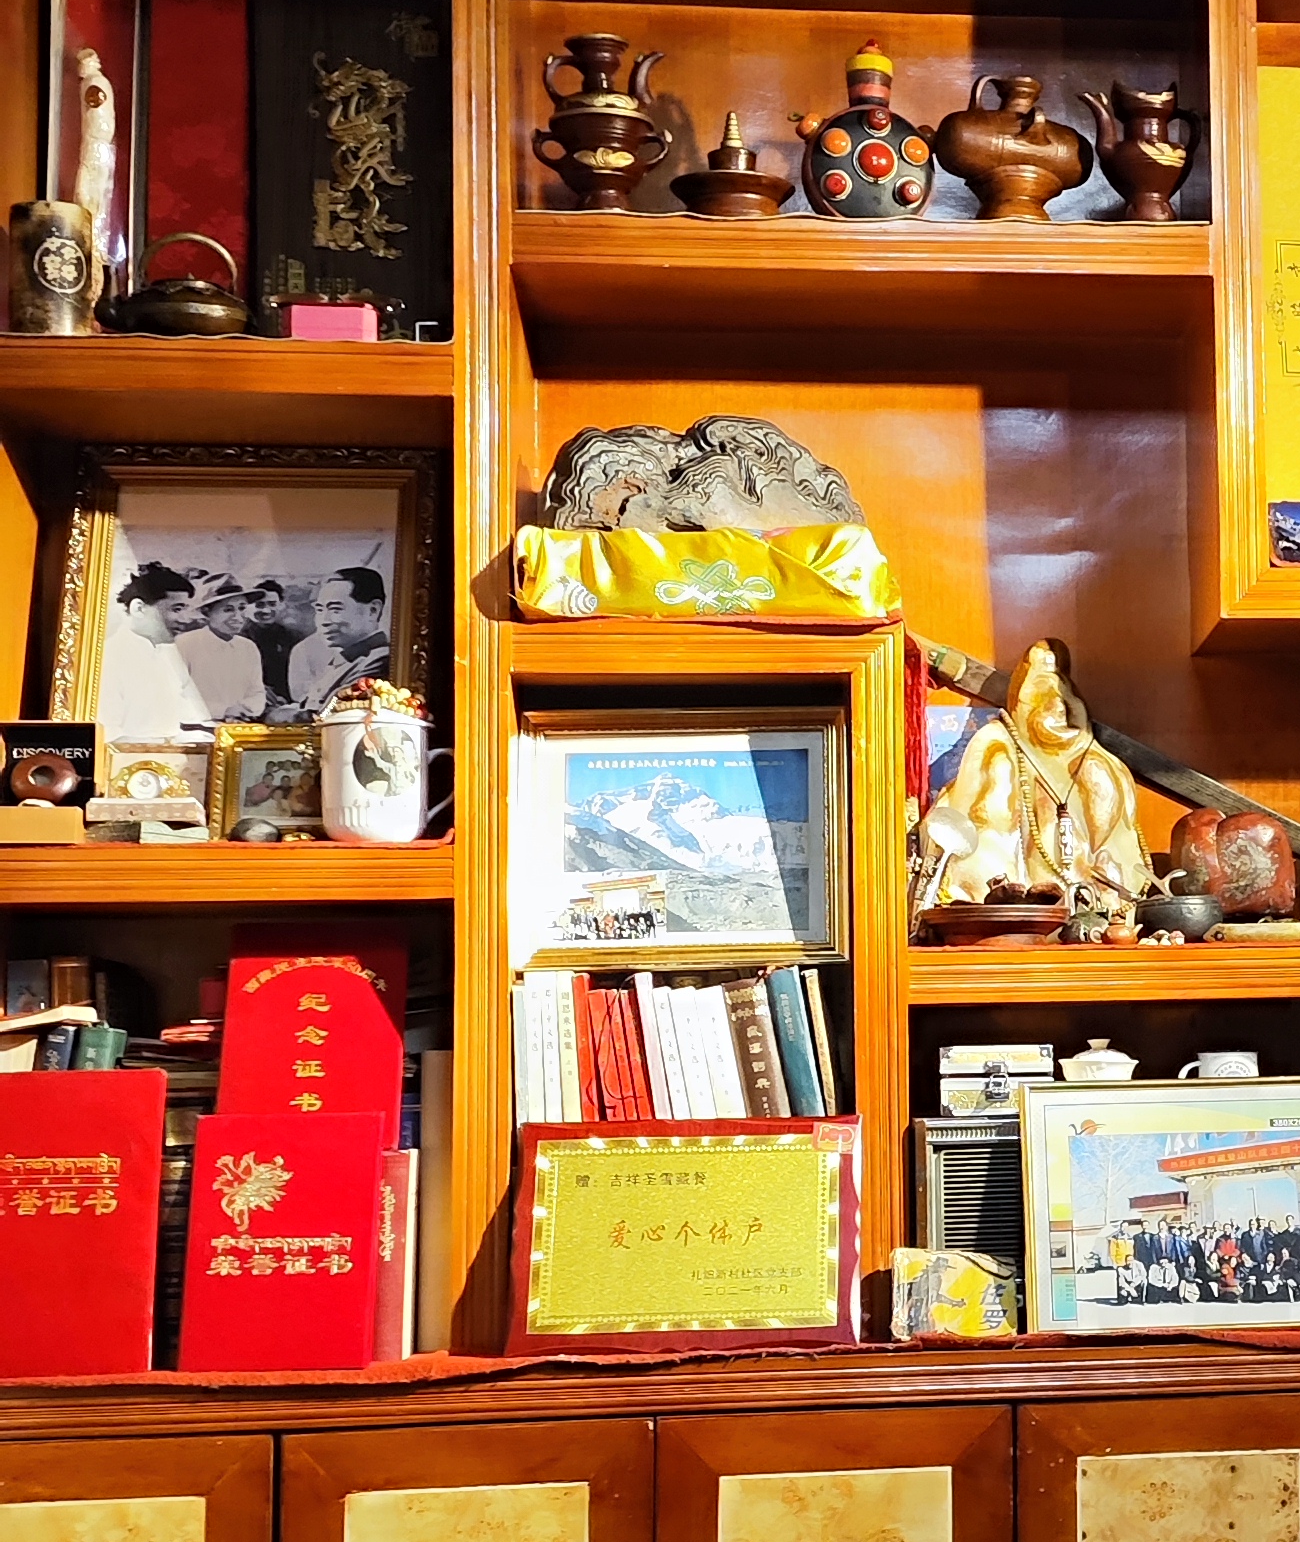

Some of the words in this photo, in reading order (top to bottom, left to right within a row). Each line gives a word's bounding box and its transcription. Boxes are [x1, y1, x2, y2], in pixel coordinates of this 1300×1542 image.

[288, 992, 332, 1113] 纪念证书
[0, 1188, 119, 1216] 誉证书
[607, 1216, 764, 1250] 爱心个体户
[206, 1254, 354, 1277] 荣誉证书
